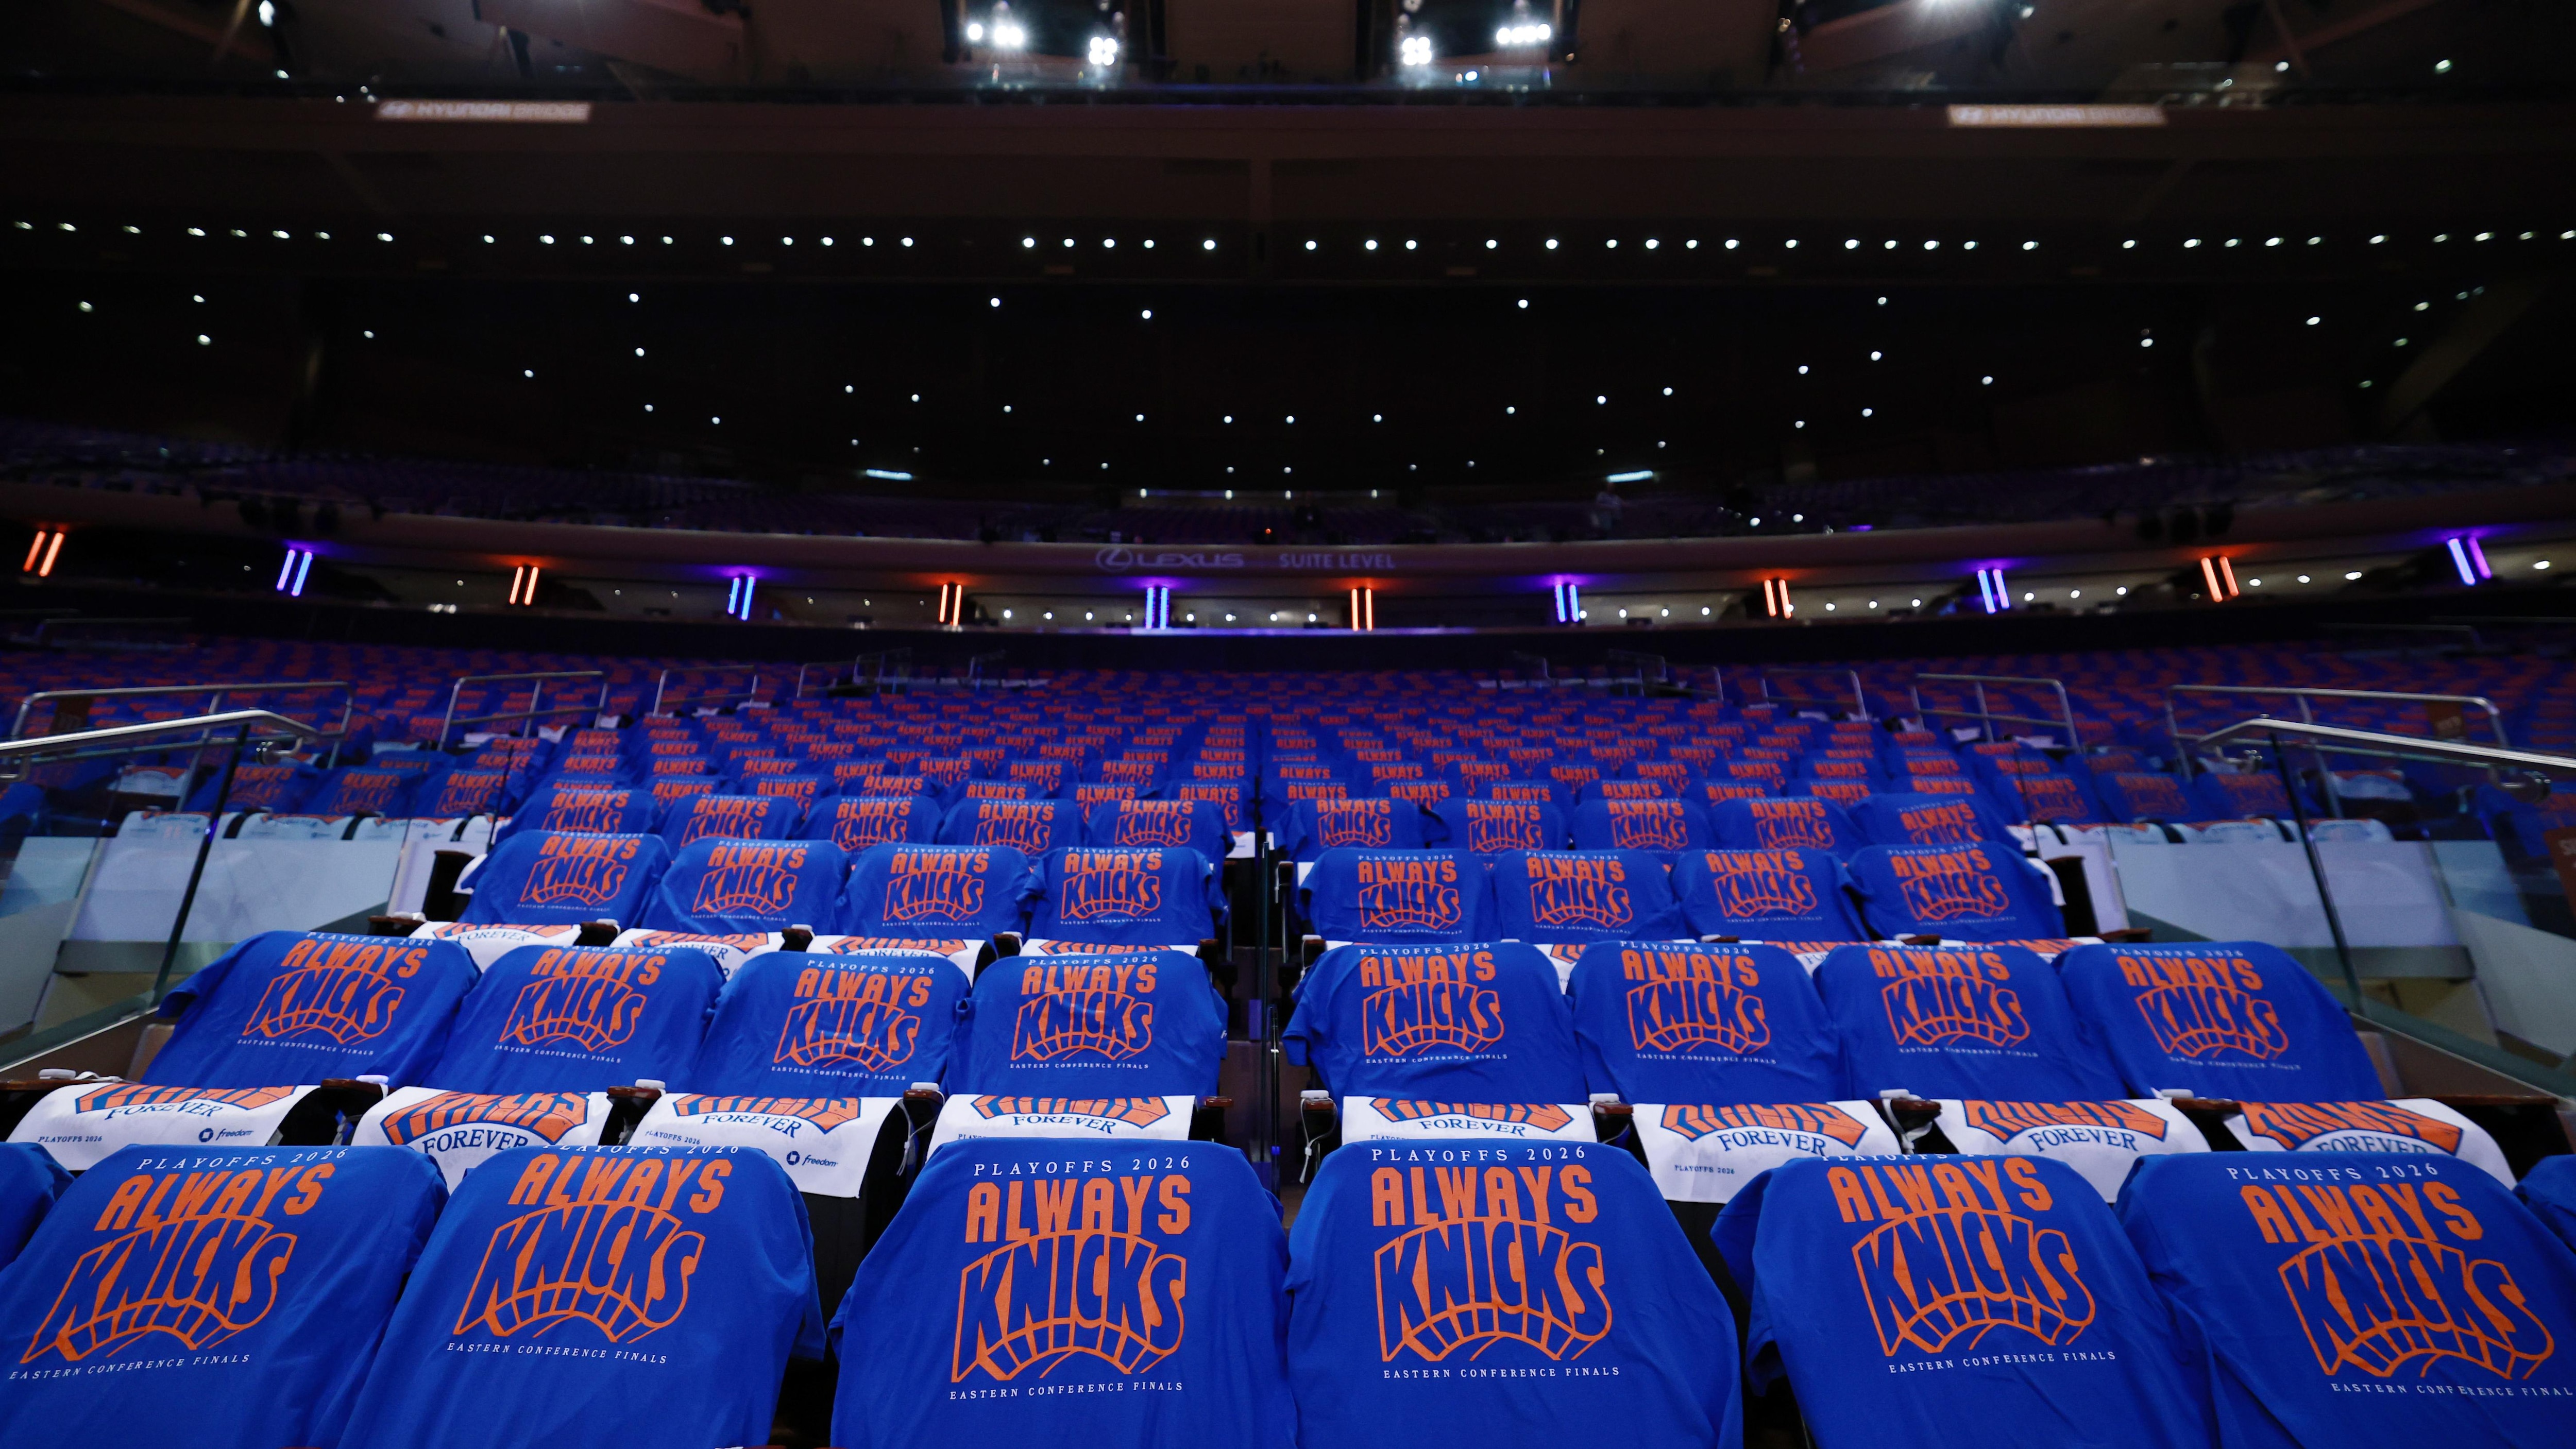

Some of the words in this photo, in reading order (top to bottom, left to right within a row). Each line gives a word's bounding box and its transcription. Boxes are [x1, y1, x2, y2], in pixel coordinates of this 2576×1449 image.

[1138, 552, 1244, 567] LEXUS
[1279, 553, 1332, 567] SUITE
[1340, 553, 1394, 568] LEVEL
[967, 785, 1026, 799] ALWAYS
[1077, 787, 1135, 800] ALWAYS
[1180, 787, 1239, 802] ALWAYS
[1288, 786, 1347, 798] ALWAYS
[1391, 785, 1450, 799] ALWAYS
[1492, 788, 1550, 801] ALWAYS
[693, 797, 770, 817] ALWAYS
[836, 801, 911, 819] ALWAYS
[979, 804, 1054, 820] ALWAYS
[1120, 799, 1193, 814] ALWAYS
[1317, 799, 1391, 813] ALWAYS
[1467, 803, 1540, 821] ALWAYS
[540, 835, 641, 861] ALWAYS
[707, 846, 808, 870] ALWAYS
[890, 853, 989, 873] ALWAYS
[1064, 852, 1162, 873] ALWAYS
[1359, 860, 1457, 883] ALWAYS
[1527, 858, 1625, 882] ALWAYS
[1705, 851, 1804, 873] ALWAYS
[1891, 852, 1991, 877] ALWAYS
[520, 855, 626, 906] KNICKS
[692, 865, 798, 915] KNICKS
[884, 871, 984, 921] KNICKS
[1061, 868, 1160, 919] KNICKS
[1359, 879, 1462, 929] KNICKS
[1530, 876, 1633, 929] KNICKS
[307, 931, 389, 945] PLAYOFFS
[551, 945, 629, 953] AYOFFS
[1360, 947, 1443, 956] PLAYOFFS
[1454, 943, 1490, 952] 2026
[1620, 941, 1703, 953] PLAYOFFS
[281, 940, 428, 977] ALWAYS
[531, 949, 667, 985] ALWAYS
[807, 960, 889, 973] PLAYOFFS
[1360, 951, 1496, 987] ALWAYS
[1621, 950, 1759, 986] ALWAYS
[1868, 949, 2010, 980] ALWAYS
[1022, 964, 1157, 995] ALWAYS
[2116, 956, 2263, 990] ALWAYS
[794, 968, 932, 1007] ALWAYS
[242, 966, 405, 1045] KNICKS
[499, 975, 648, 1052] KNICKS
[1626, 978, 1770, 1054] KNICKS
[1882, 974, 2030, 1047] KNICKS
[1011, 989, 1153, 1061] KNICKS
[1363, 980, 1504, 1056] KNICKS
[2136, 983, 2289, 1060] KNICKS
[774, 997, 921, 1072] KNICKS
[814, 1070, 869, 1079] CONFERENCE
[105, 1101, 224, 1120] FOREVER
[215, 1128, 251, 1140] freedom
[702, 1114, 802, 1138] FOREVER
[1012, 1115, 1116, 1134] FOREVER
[1420, 1118, 1526, 1137] FOREVER
[422, 1129, 528, 1153] FOREVER
[645, 1130, 682, 1142] PLAYOFFS
[685, 1136, 701, 1145] 2026
[1717, 1129, 1827, 1156] FOREVER
[2028, 1128, 2138, 1152] FOREVER
[137, 1155, 276, 1171] PLAYOFFS
[291, 1149, 348, 1162] 2026
[688, 1146, 739, 1154] 2026
[802, 1154, 837, 1168] freedom
[1372, 1149, 1507, 1161] PLAYOFFS
[1527, 1146, 1584, 1160] 2026
[974, 1161, 1111, 1175] PLAYOFFS
[1133, 1156, 1189, 1170] 2026
[1674, 1164, 1714, 1173] PLAYOFFS
[2227, 1168, 2361, 1180] PLAYOFFS
[2376, 1163, 2437, 1178] 2026
[508, 1154, 733, 1213] ALWAYS
[1371, 1165, 1598, 1226] ALWAYS
[1827, 1157, 2053, 1222] ALWAYS
[95, 1162, 335, 1230] ALWAYS
[965, 1174, 1190, 1242] ALWAYS
[2240, 1182, 2483, 1243] ALWAYS
[453, 1203, 705, 1343] KNICKS
[1852, 1208, 2096, 1356] KNICKS
[20, 1215, 297, 1363] KNICKS
[1375, 1217, 1613, 1361] KNICKS
[951, 1230, 1186, 1383] KNICKS
[2278, 1236, 2555, 1379] KNICKS
[447, 1343, 510, 1352] EASTERN
[518, 1346, 606, 1357] CONFERENCE
[615, 1351, 666, 1363] FINALS
[1889, 1360, 1953, 1373] EASTERN
[1963, 1354, 2054, 1366] CONFERENCE
[2063, 1352, 2115, 1360] FINALS
[9, 1368, 81, 1379] EASTERN
[88, 1359, 184, 1373] CONFERENCE
[193, 1355, 249, 1365] FINALS
[1384, 1370, 1449, 1378] EASTERN
[1566, 1368, 1619, 1376] FINALS
[950, 1389, 1018, 1399] EASTERN
[1029, 1383, 1123, 1395] CONFERENCE
[1133, 1382, 1181, 1390] FINALS
[2331, 1384, 2406, 1392] EASTERN
[2417, 1386, 2514, 1395] CONFERENCE
[2521, 1387, 2576, 1395] FINAL
